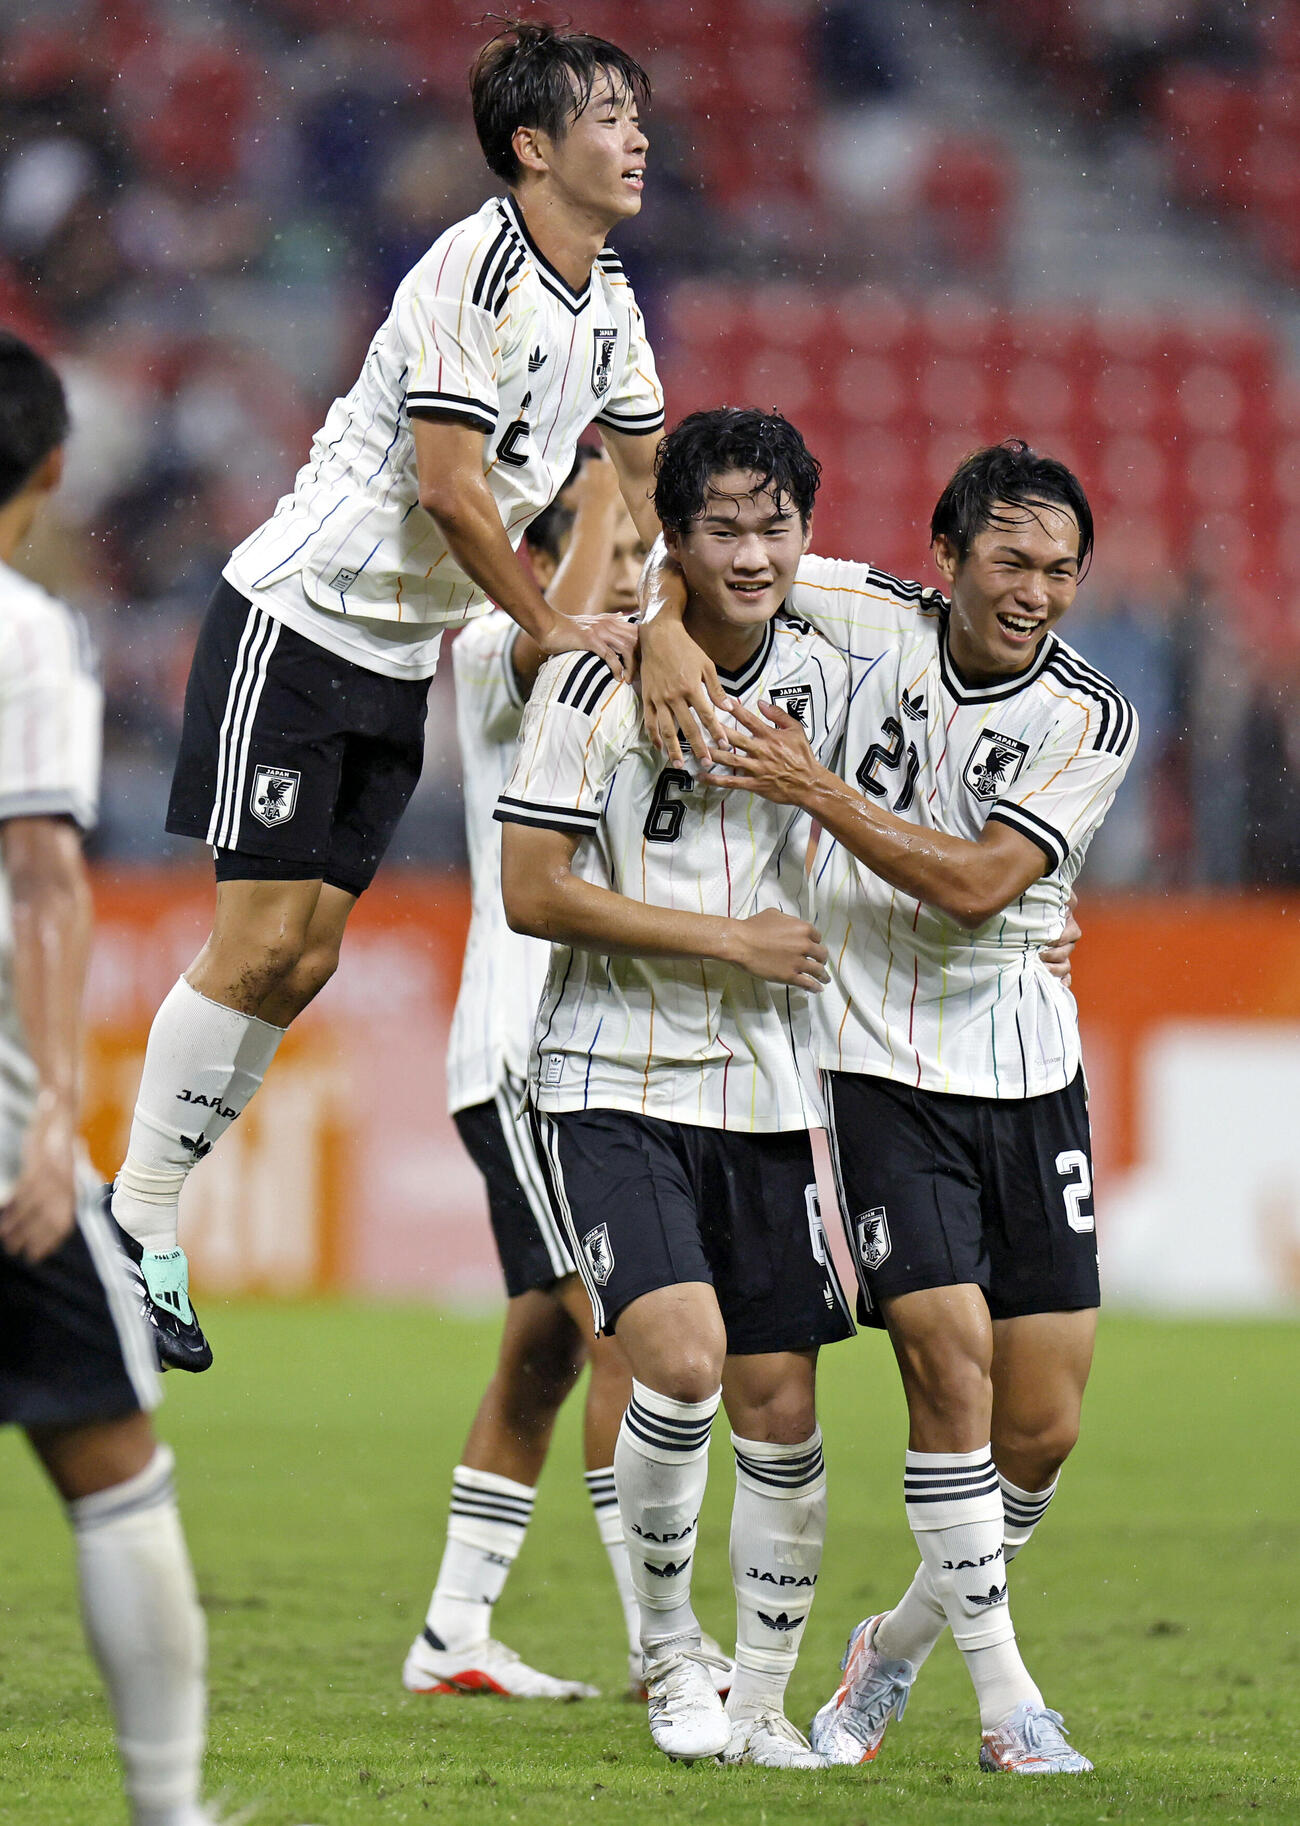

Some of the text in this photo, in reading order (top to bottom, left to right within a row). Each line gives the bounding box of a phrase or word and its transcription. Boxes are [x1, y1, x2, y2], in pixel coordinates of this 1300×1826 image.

[780, 687, 802, 696] JAPAN
[992, 734, 1018, 748] JAPAN
[855, 716, 920, 814] 21
[266, 769, 290, 778] JAPAN
[973, 777, 996, 795] JFA
[261, 806, 280, 818] JFA
[643, 768, 694, 845] 6
[860, 1211, 875, 1221] JAPAN
[585, 1229, 598, 1243] JAPAN
[941, 1543, 1004, 1569] JAPA
[745, 1567, 818, 1587] JAPA
